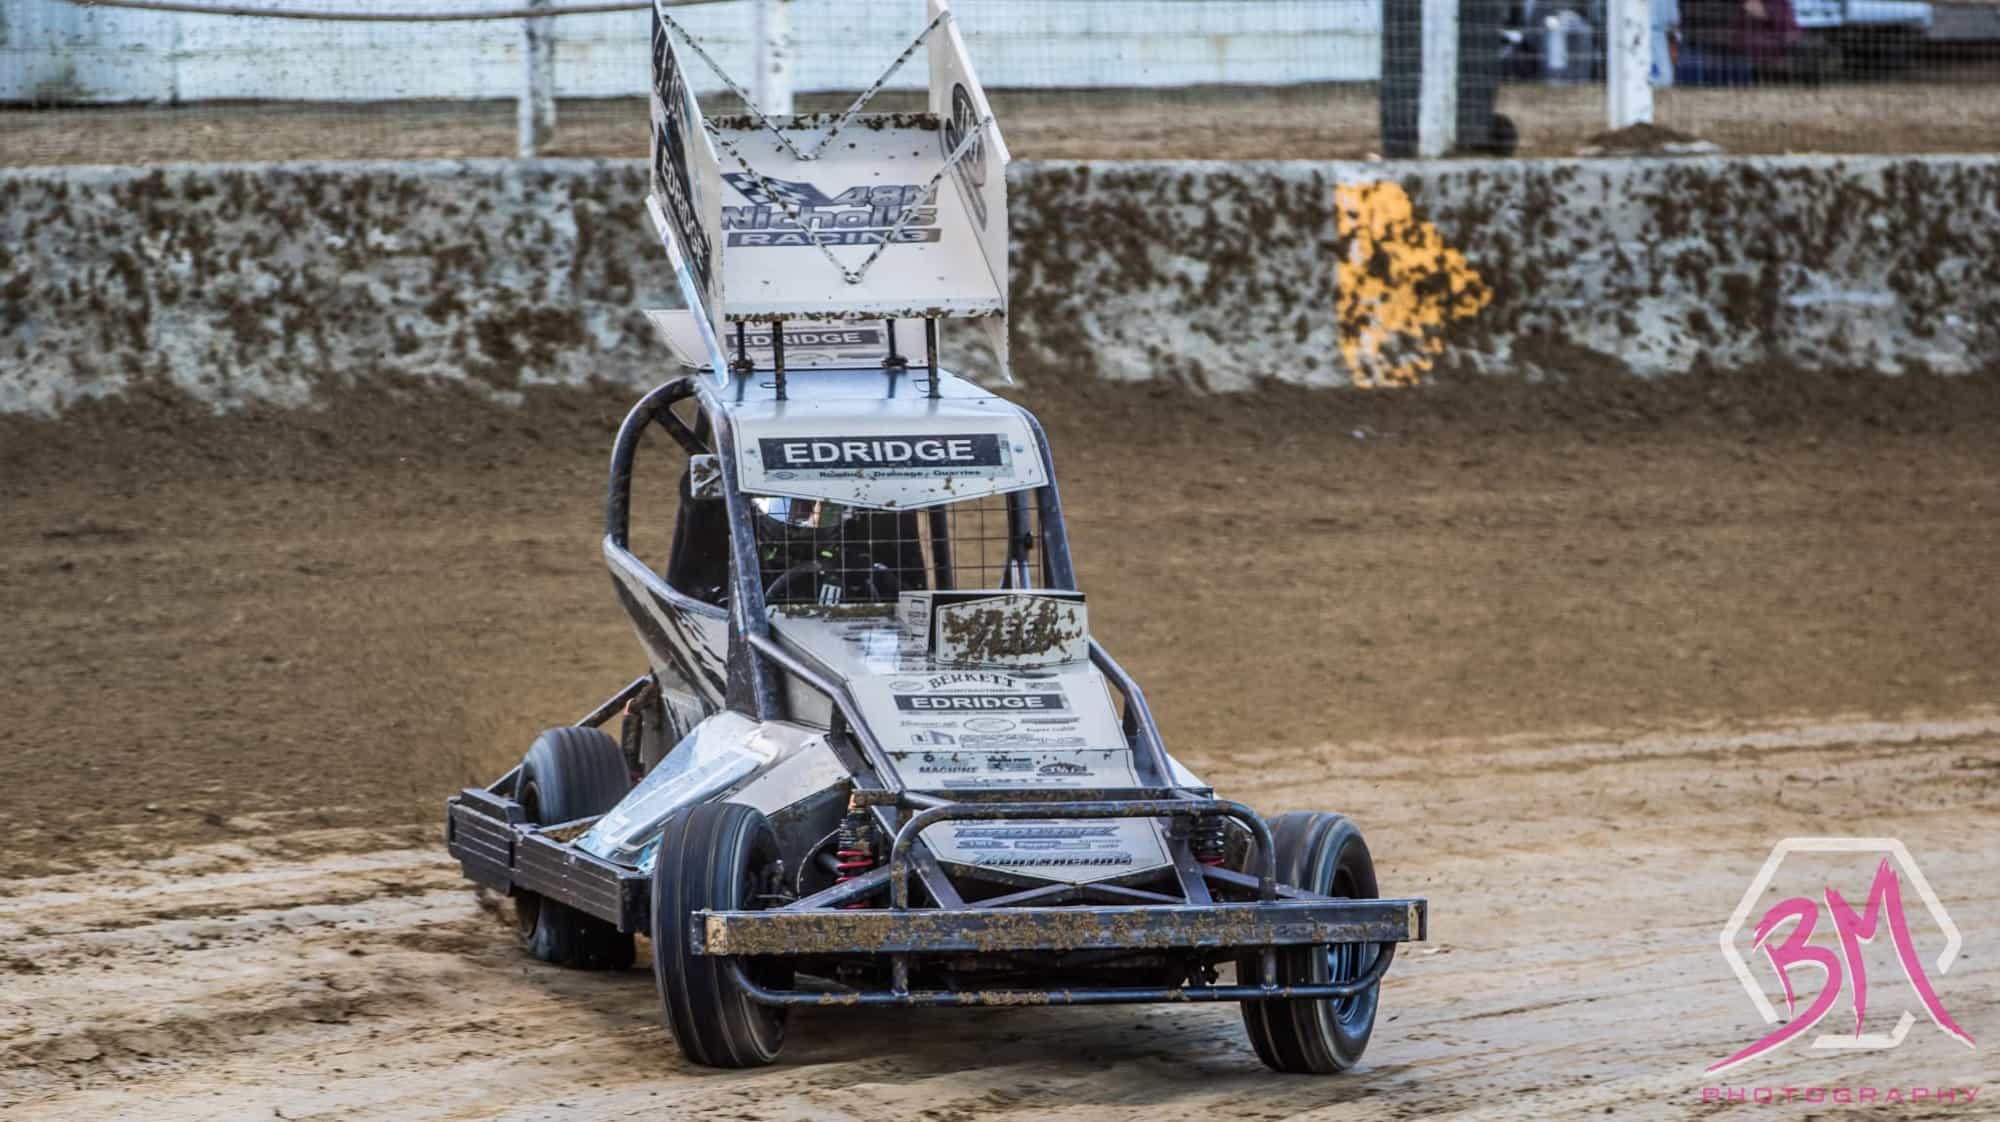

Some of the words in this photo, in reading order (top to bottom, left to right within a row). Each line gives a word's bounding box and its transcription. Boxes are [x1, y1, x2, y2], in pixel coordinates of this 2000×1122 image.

[721, 205, 938, 230] Nicholls
[740, 230, 929, 246] RACING
[783, 439, 974, 463] EDRIDGE
[928, 672, 1017, 690] BERKETT
[911, 697, 1044, 708] EDRIDGE
